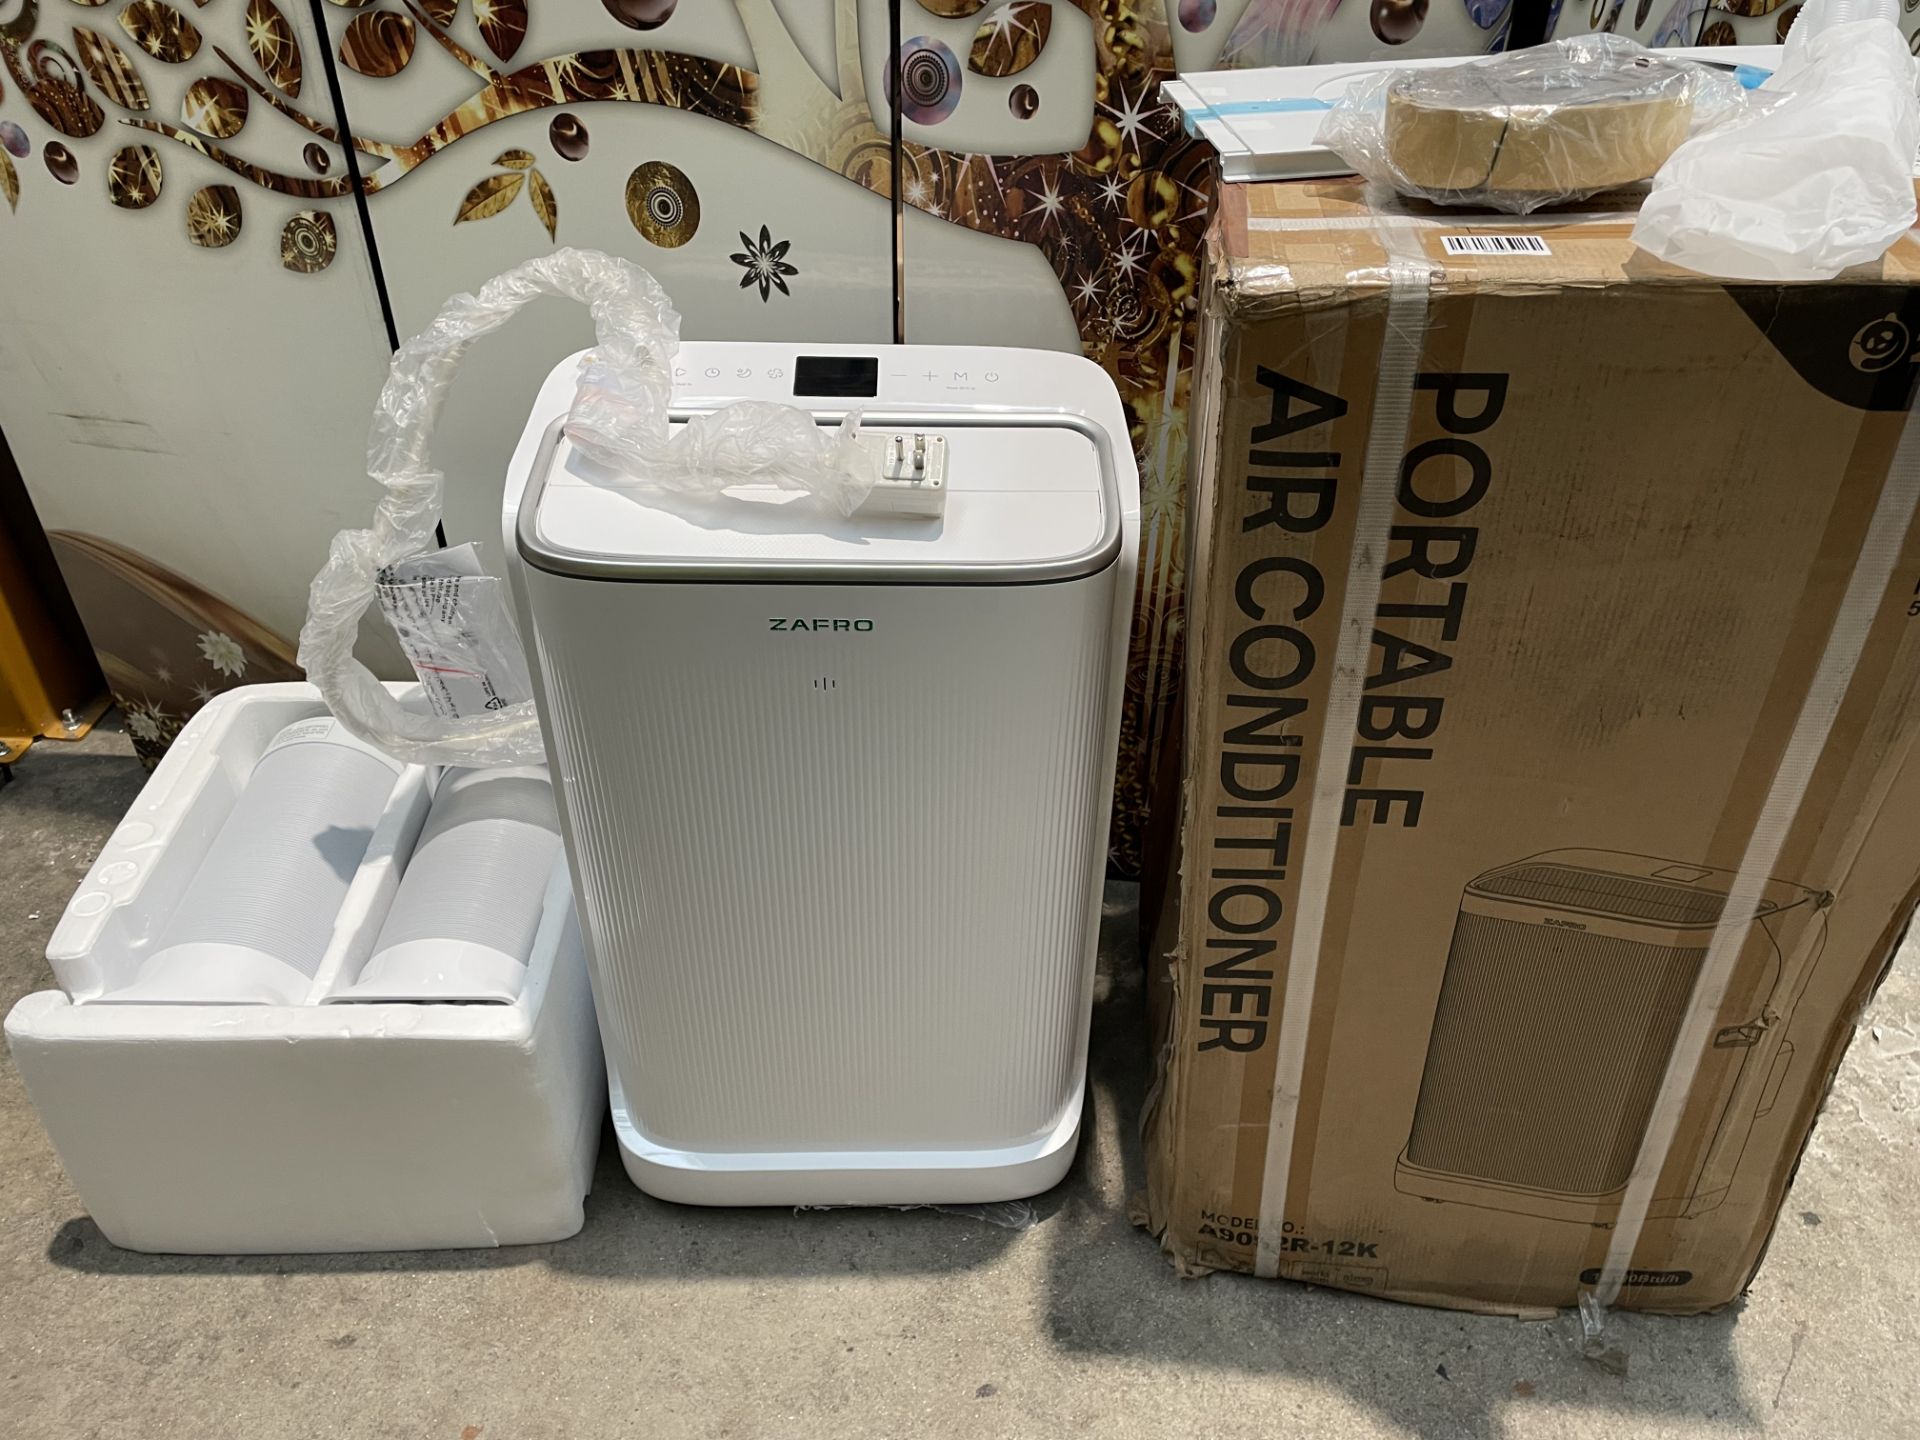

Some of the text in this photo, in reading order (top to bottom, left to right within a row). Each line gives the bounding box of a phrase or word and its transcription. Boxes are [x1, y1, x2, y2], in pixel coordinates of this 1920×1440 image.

[768, 618, 874, 632] ZAFRO
[1197, 364, 1350, 1053] AIR CONDITIONER
[1339, 371, 1510, 828] PORTABLE
[1198, 1223, 1379, 1259] A902R-12K
